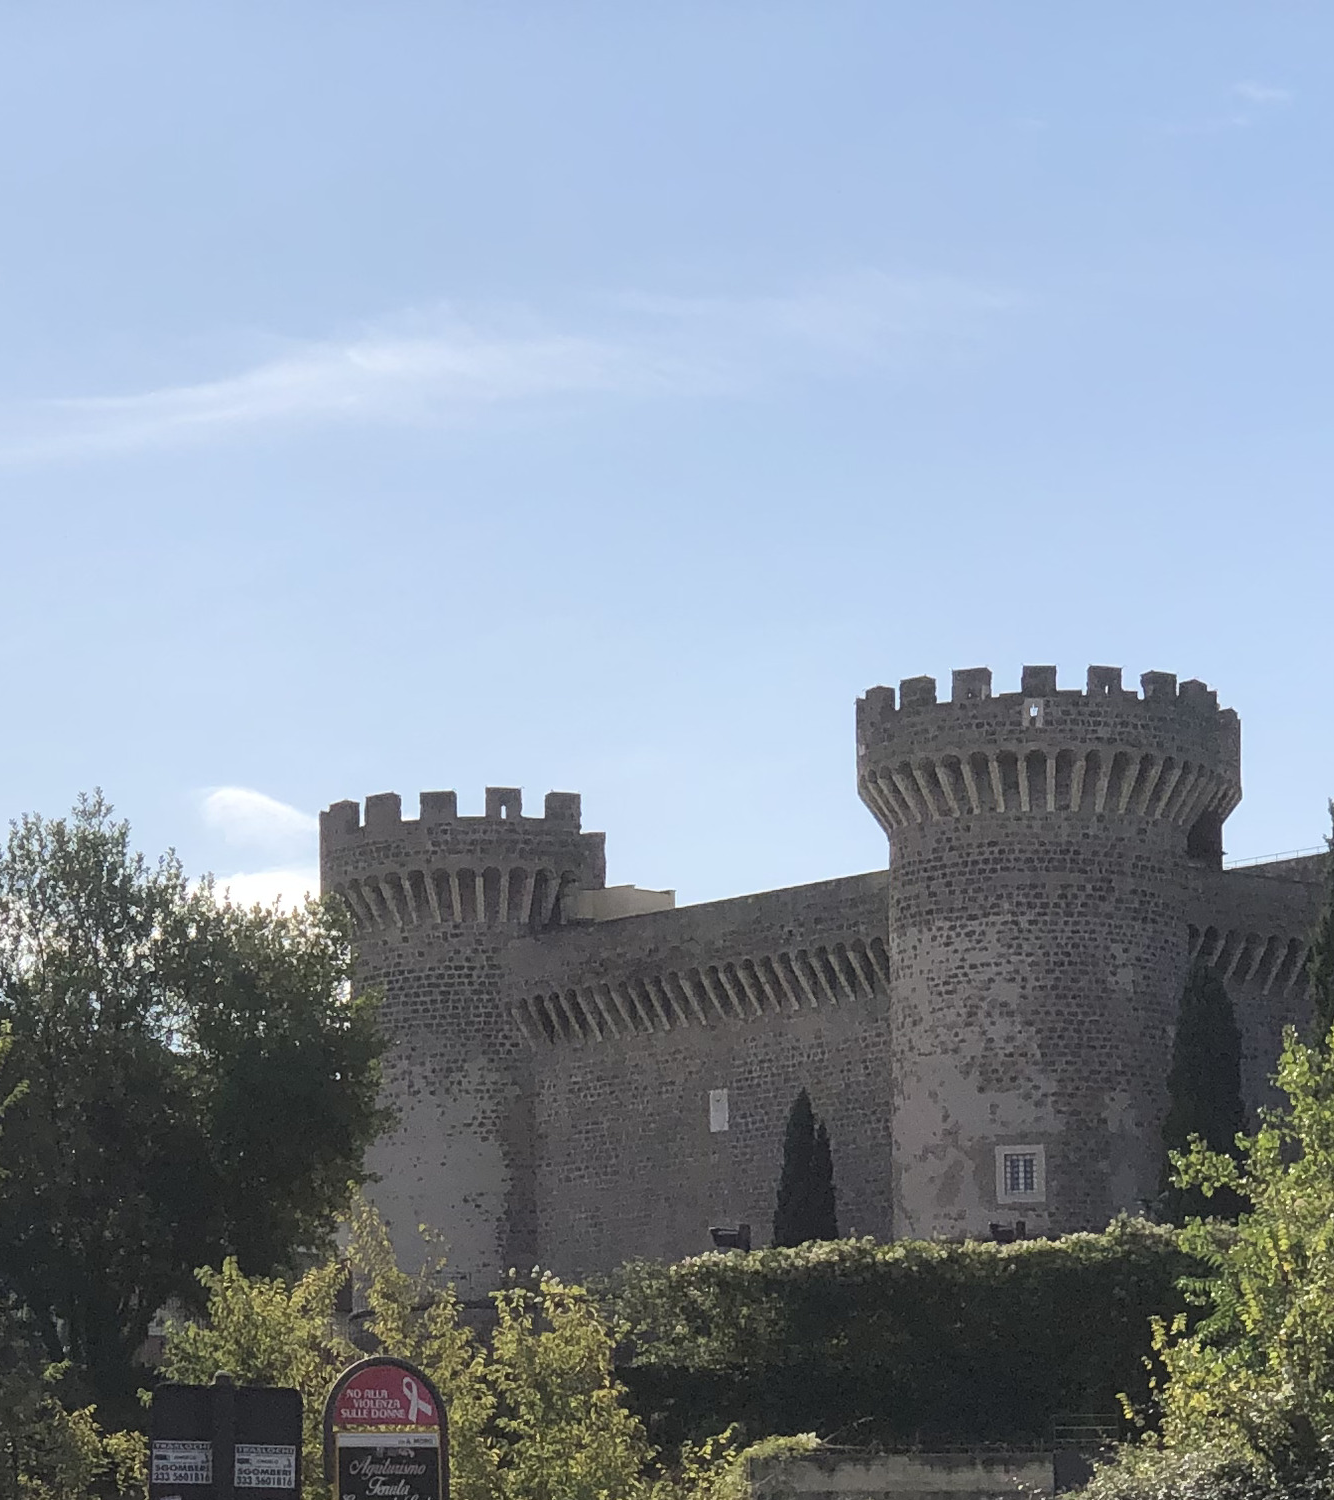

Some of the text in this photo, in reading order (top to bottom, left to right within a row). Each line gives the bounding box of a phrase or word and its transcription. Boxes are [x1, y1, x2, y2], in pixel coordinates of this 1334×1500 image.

[347, 1389, 388, 1399] NO ALLA
[353, 1399, 401, 1409] VIOLENZA
[340, 1408, 406, 1419] SULLE DONNE
[155, 1464, 209, 1472] SGOMBERI
[237, 1468, 292, 1477] SGOMBERI
[349, 1455, 426, 1480] Agriturismo
[366, 1476, 411, 1496] Tenuta
